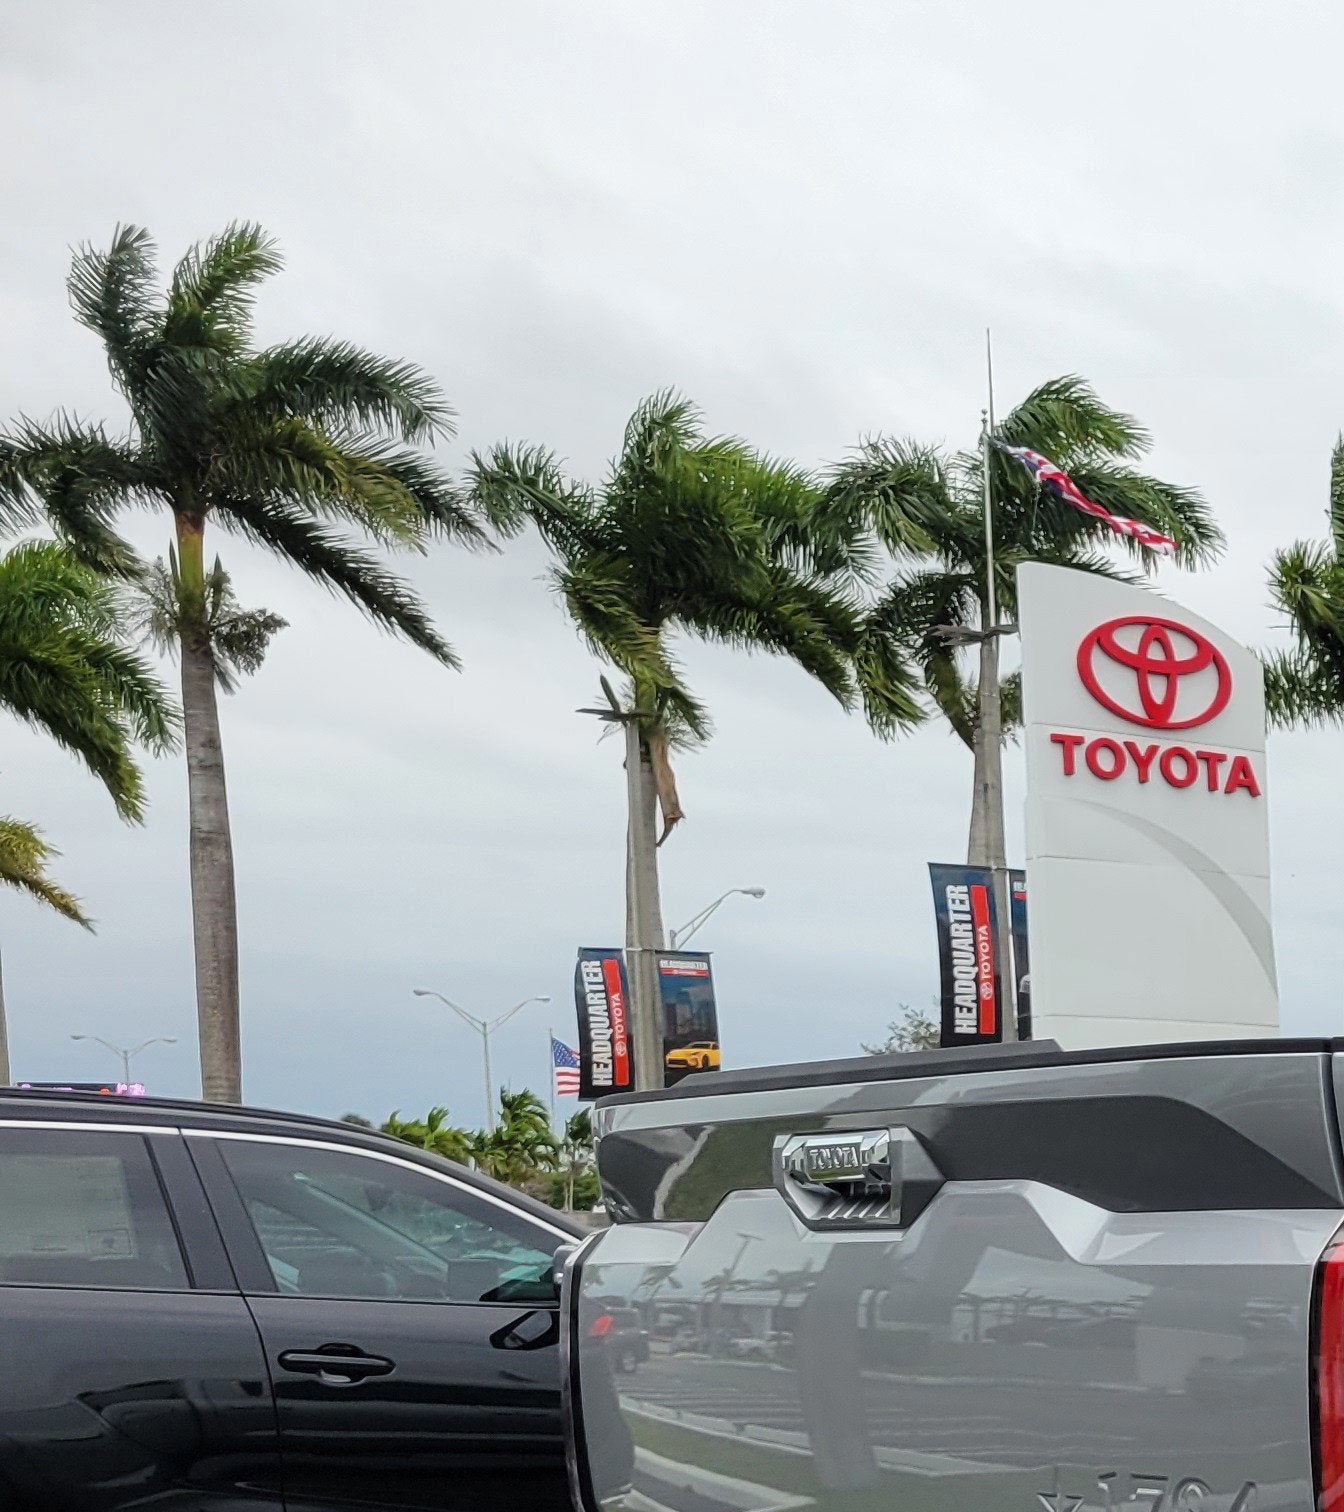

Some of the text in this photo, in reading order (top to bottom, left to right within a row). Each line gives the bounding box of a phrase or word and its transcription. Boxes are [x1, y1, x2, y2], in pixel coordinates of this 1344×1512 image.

[1050, 733, 1261, 798] TOYOTA
[946, 884, 978, 1034] HEADQUARTER
[977, 925, 992, 979] TOYOTA
[581, 960, 613, 1086] HEADQUARTER
[612, 993, 628, 1040] TOYOTA
[809, 1146, 860, 1170] TOYOTA
